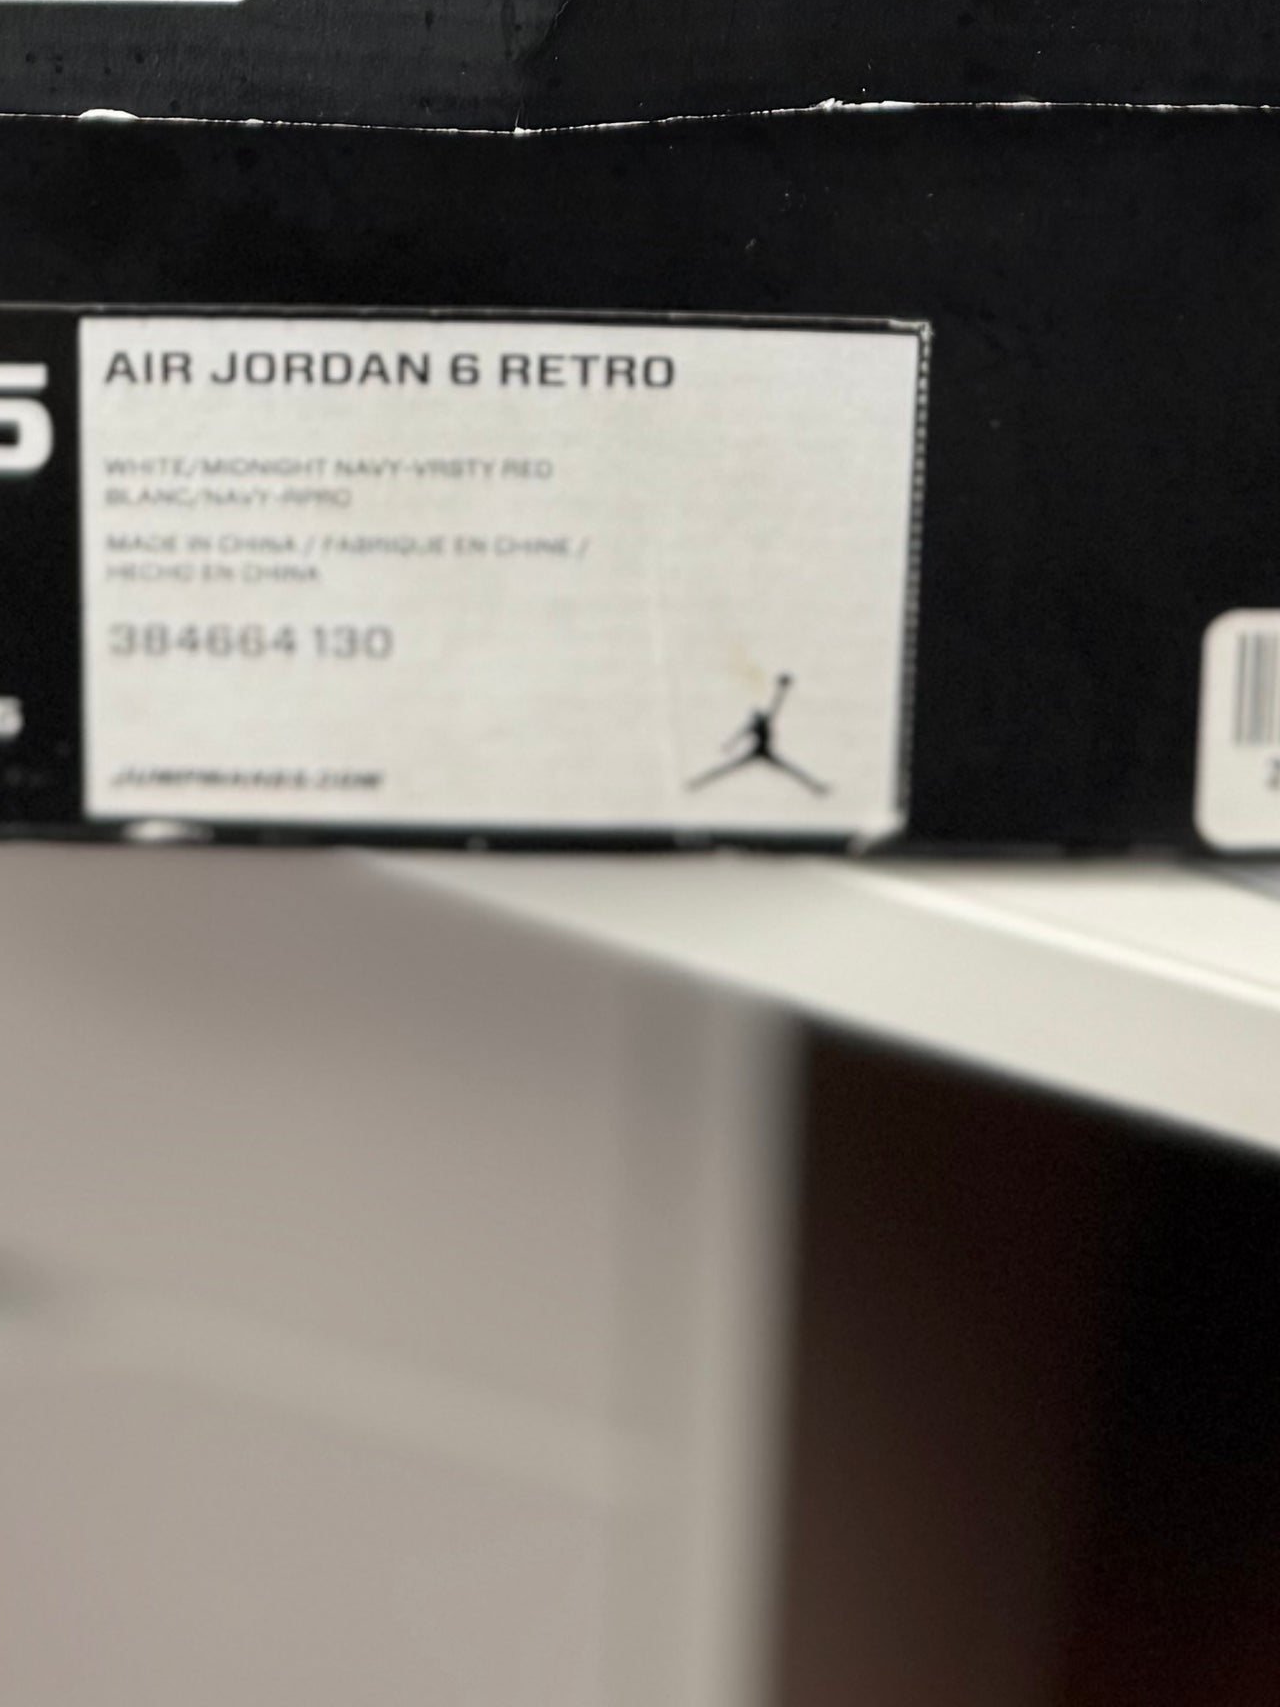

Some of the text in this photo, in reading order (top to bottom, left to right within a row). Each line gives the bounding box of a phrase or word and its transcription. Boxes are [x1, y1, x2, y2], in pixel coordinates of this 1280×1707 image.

[105, 351, 677, 388] AIR JORDAN 6 RETRO
[108, 623, 394, 660] 384664 130
